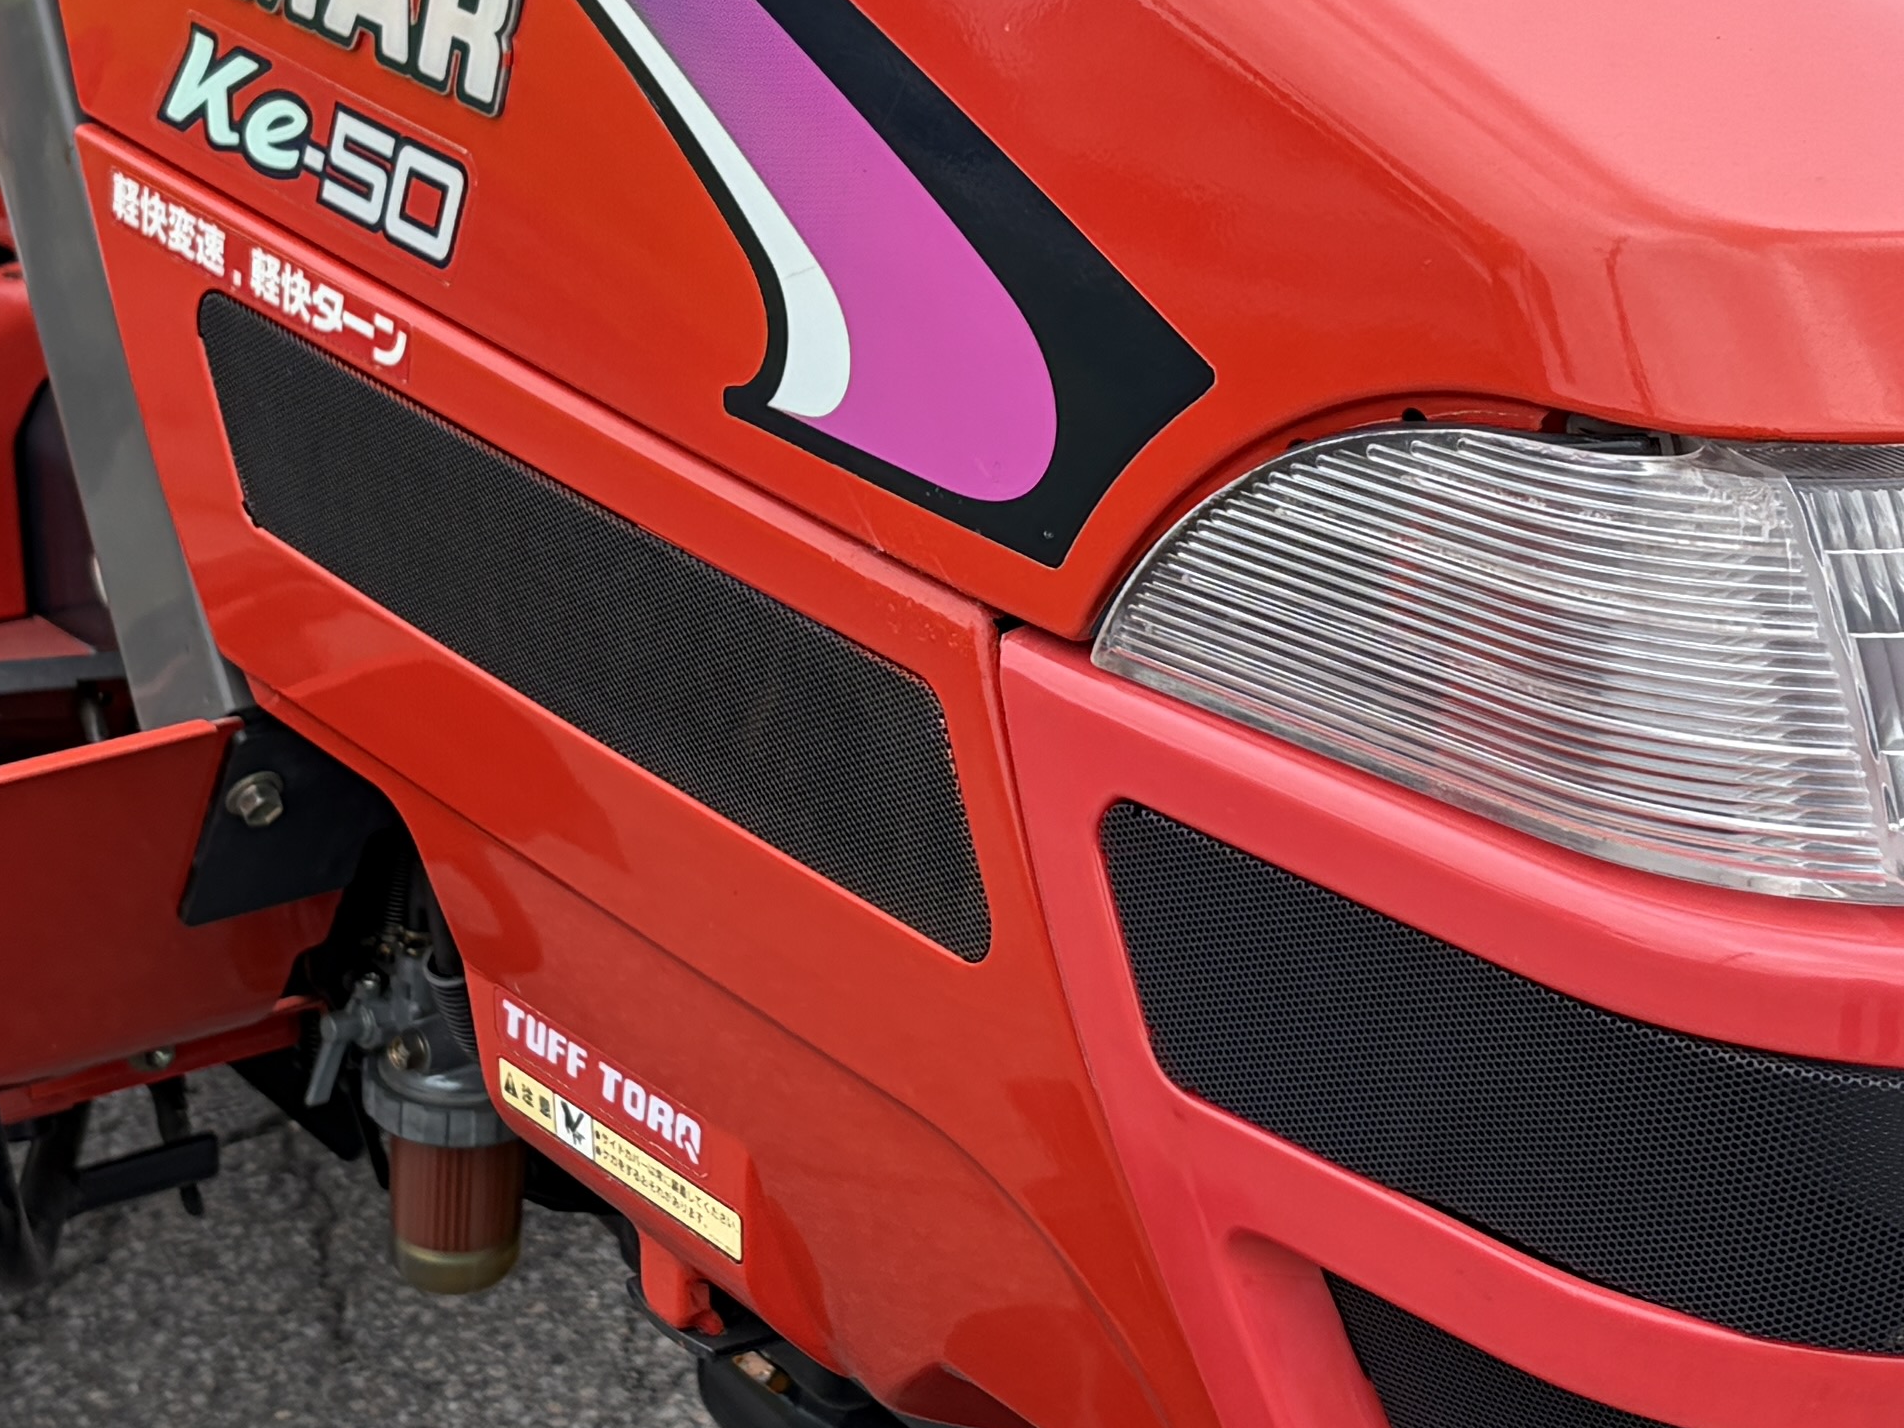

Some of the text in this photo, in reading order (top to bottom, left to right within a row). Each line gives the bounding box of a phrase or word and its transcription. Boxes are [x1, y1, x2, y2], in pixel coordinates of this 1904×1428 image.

[158, 24, 468, 269] Ke-50
[502, 998, 702, 1165] TUFF TORQ
